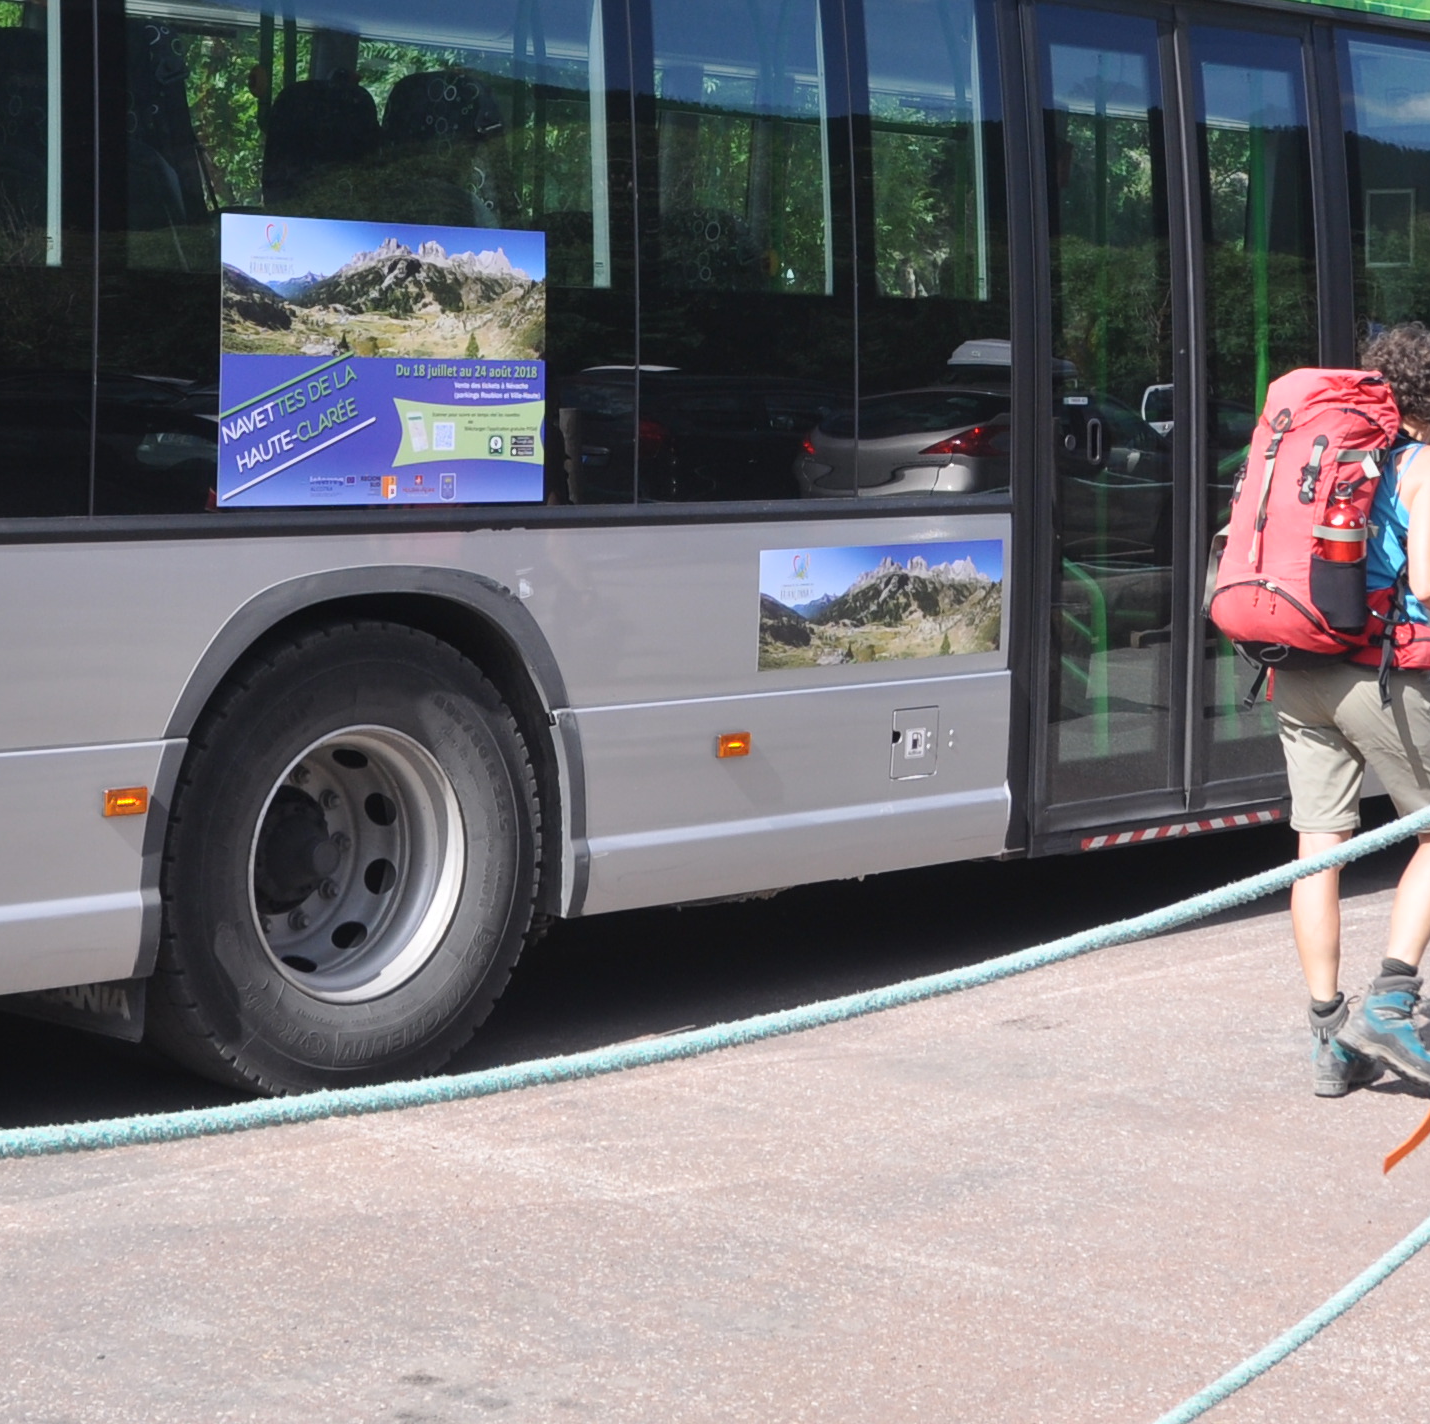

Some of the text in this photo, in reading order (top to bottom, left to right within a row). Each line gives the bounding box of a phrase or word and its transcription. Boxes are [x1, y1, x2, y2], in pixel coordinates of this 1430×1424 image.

[222, 364, 358, 445] NAVETTES DE LA
[395, 363, 538, 380] Du 18 juillet au 24 août 2018
[235, 396, 359, 473] HAUTE-CLARÉE
[336, 971, 473, 1063] MICHELIN
